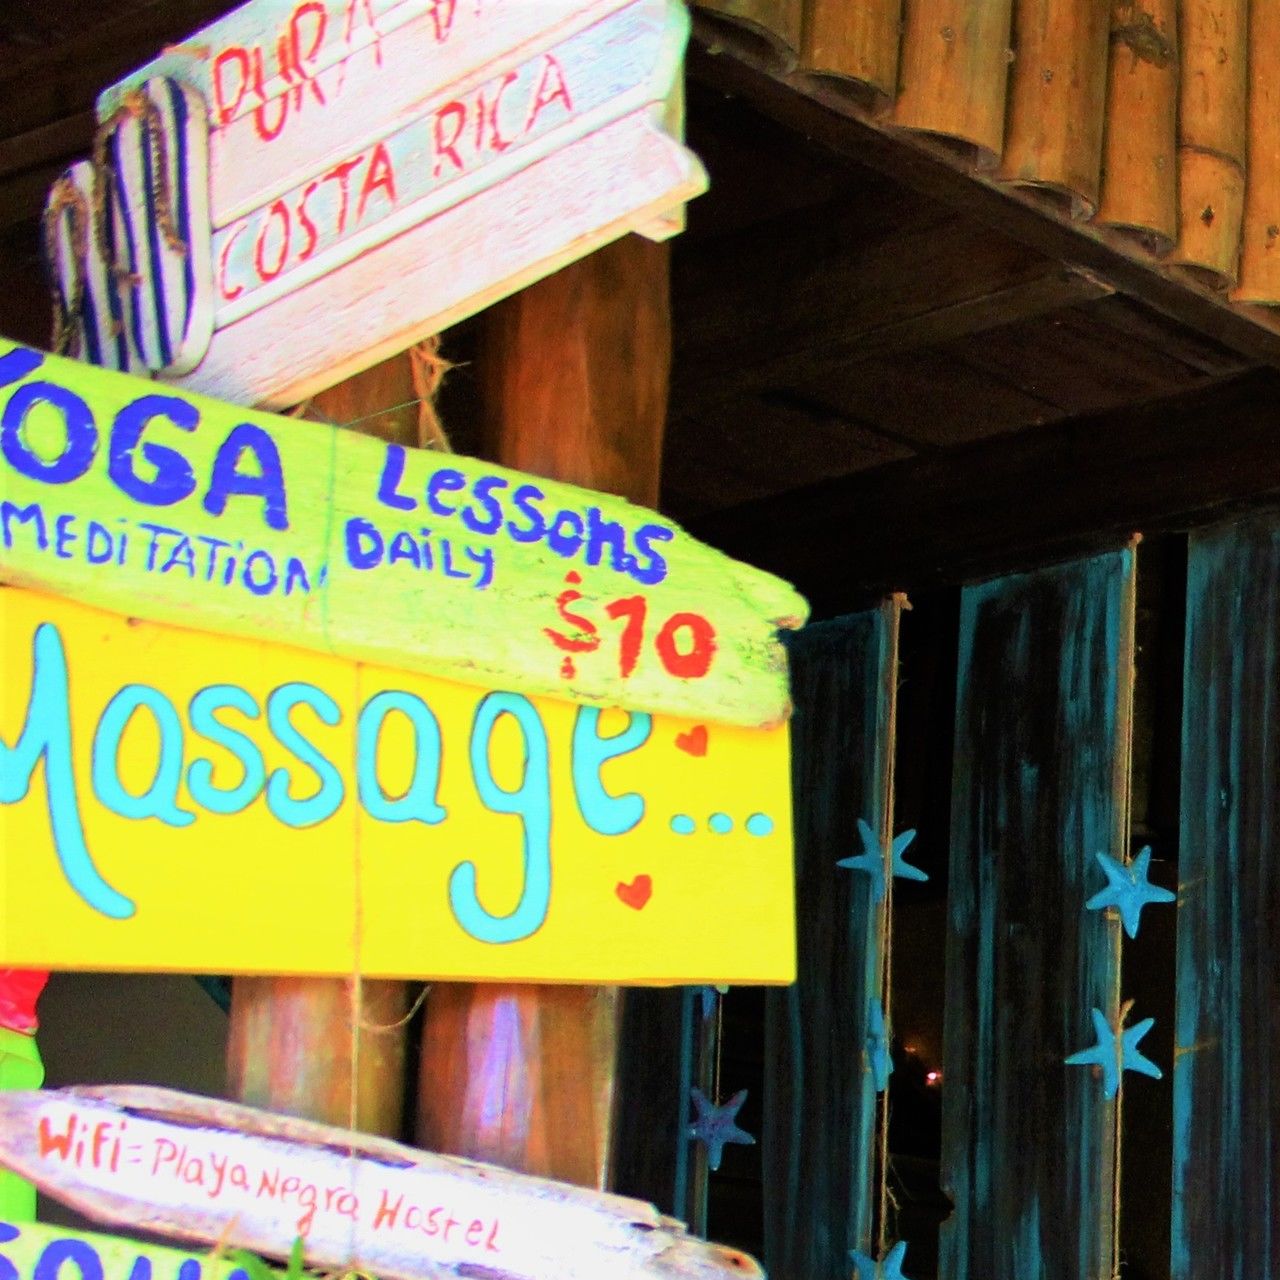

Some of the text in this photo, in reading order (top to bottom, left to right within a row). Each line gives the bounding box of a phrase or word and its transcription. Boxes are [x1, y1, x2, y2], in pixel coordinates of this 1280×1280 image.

[212, 0, 384, 141] PURA
[219, 54, 573, 300] COSTA RICA
[377, 444, 674, 585] Lessons
[542, 570, 718, 680] $10
